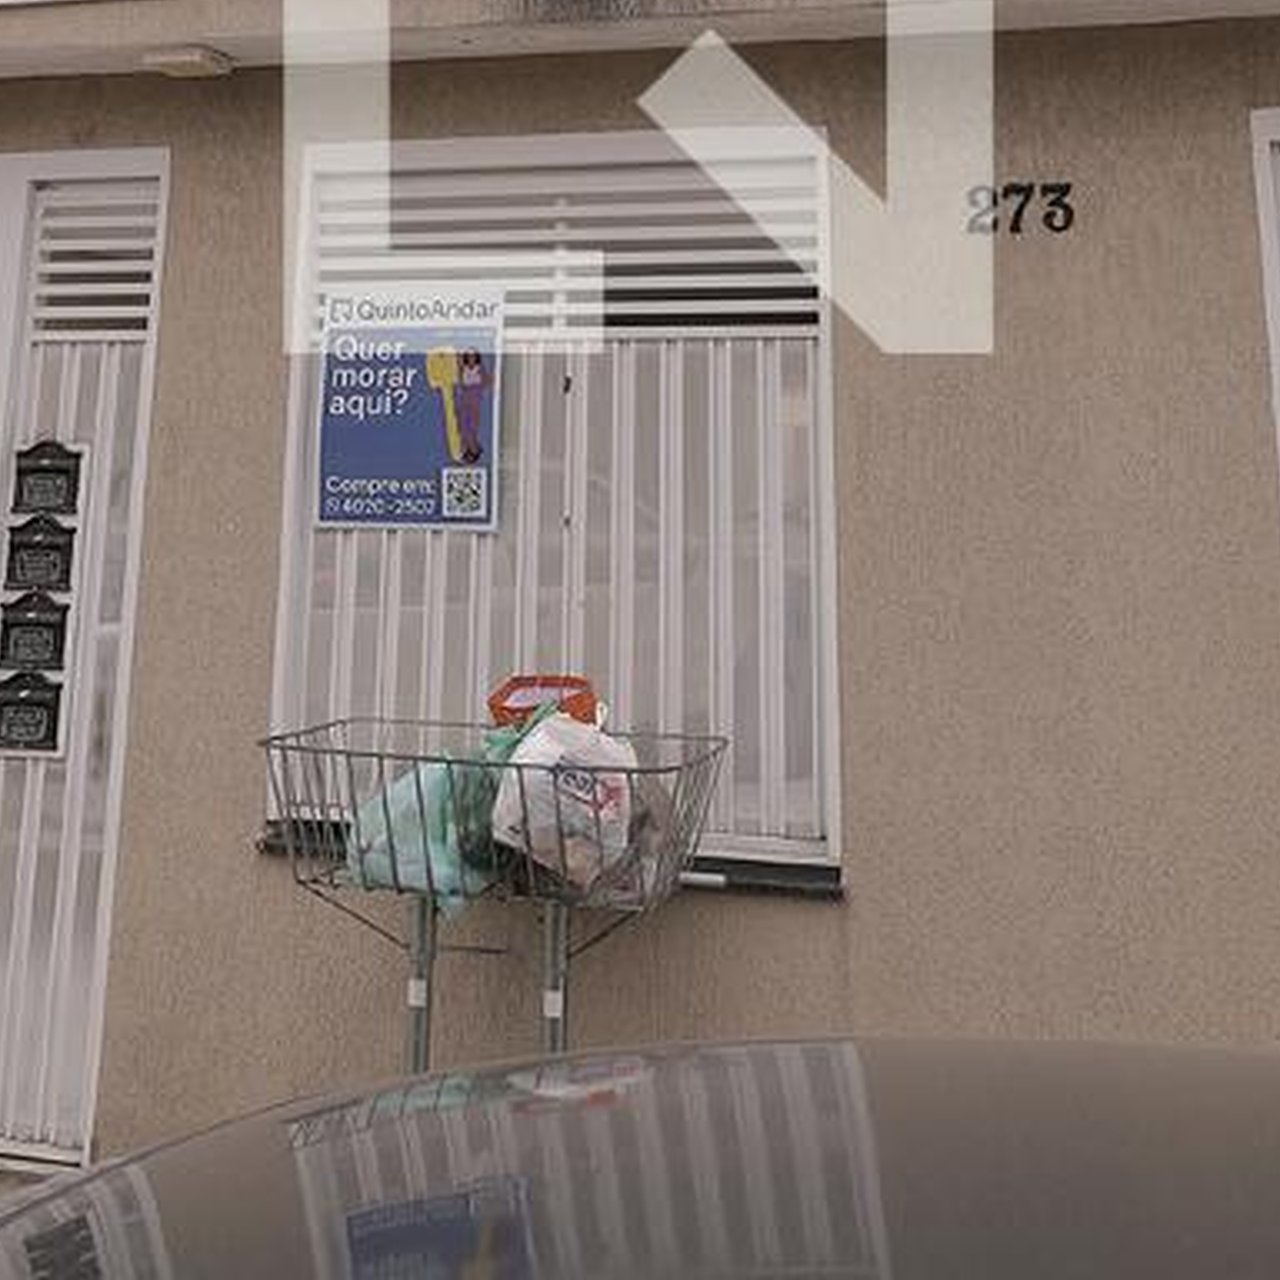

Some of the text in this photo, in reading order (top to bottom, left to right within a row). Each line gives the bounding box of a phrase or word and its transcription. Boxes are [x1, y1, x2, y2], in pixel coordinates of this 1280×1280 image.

[967, 182, 1075, 234] 273
[356, 299, 499, 320] QuintoAndar
[333, 334, 406, 362] Quer
[331, 367, 417, 389] morar
[328, 389, 409, 419] aqui?
[325, 475, 400, 497] Compre
